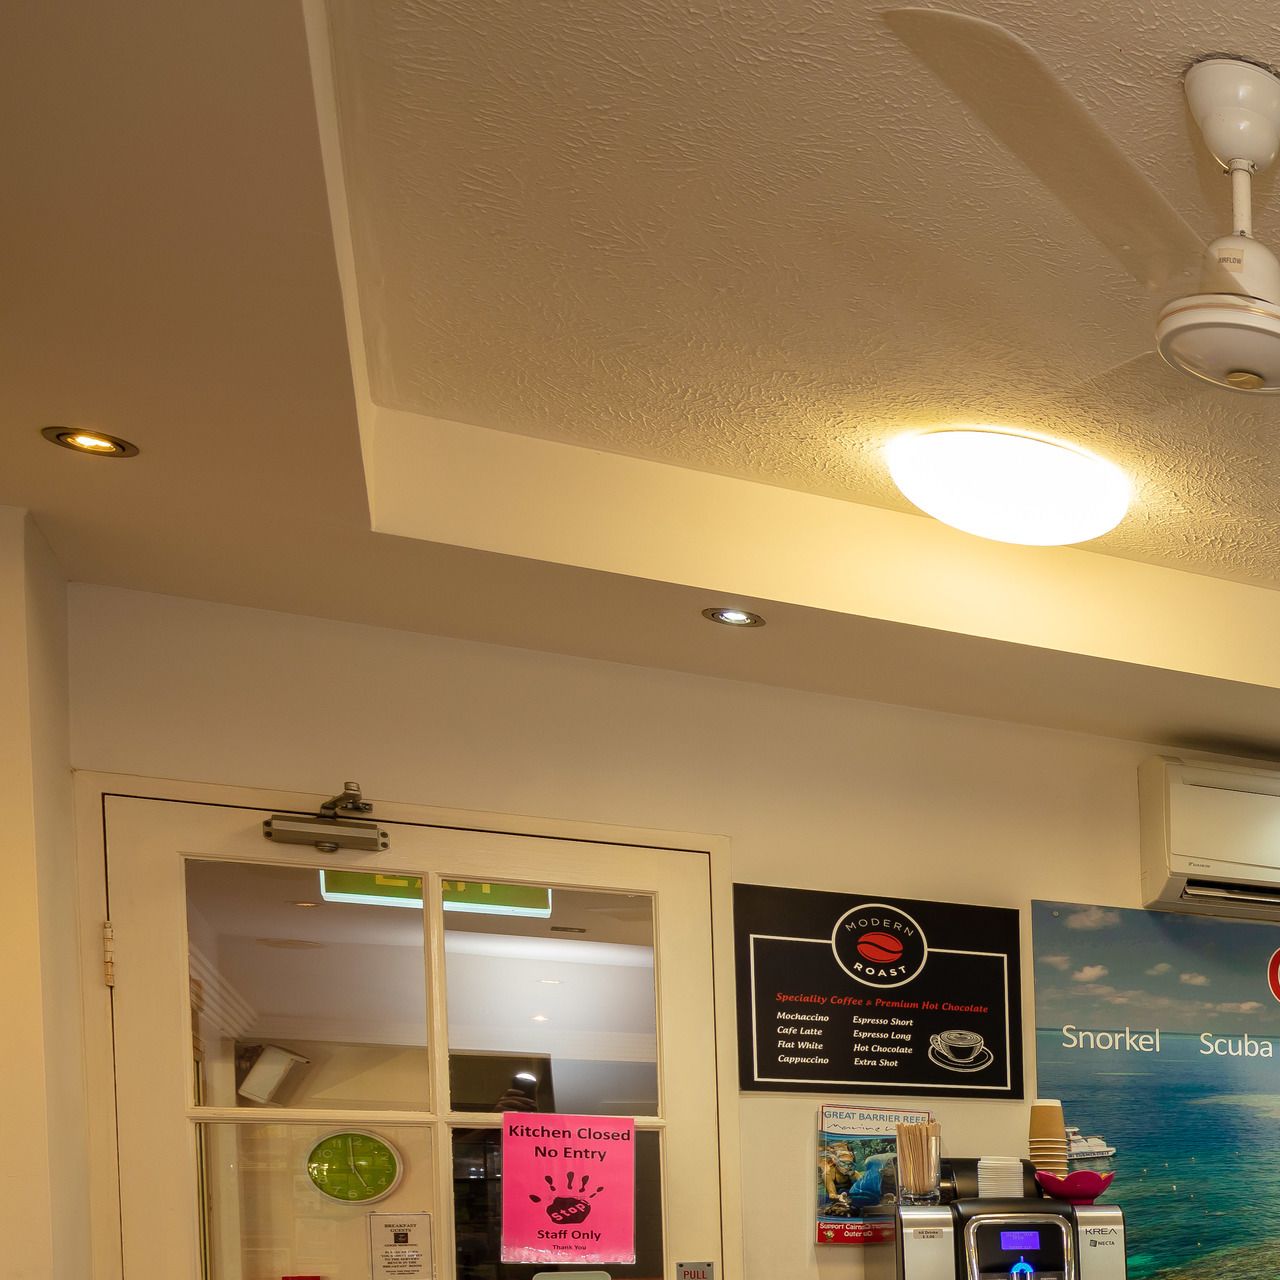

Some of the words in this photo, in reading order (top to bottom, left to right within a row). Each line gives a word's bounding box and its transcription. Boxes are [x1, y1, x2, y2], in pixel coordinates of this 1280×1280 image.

[845, 918, 914, 936] MODERN
[853, 962, 906, 977] ROAST
[776, 992, 827, 1005] Speciality
[830, 995, 863, 1007] Coffee
[875, 998, 919, 1009] Premium
[922, 1001, 939, 1011] Hot
[942, 1002, 989, 1014] Chocolate
[776, 1011, 829, 1022] Mochaccino
[853, 1016, 888, 1026] Espresso
[890, 1017, 914, 1027] Short
[777, 1026, 798, 1036] Cafe
[800, 1026, 823, 1036] Latte
[853, 1030, 889, 1041] Espresso
[891, 1031, 912, 1042] Long
[1062, 1024, 1160, 1052] Snorkel
[777, 1040, 795, 1049] Flat
[798, 1041, 823, 1050] White
[854, 1044, 869, 1053] Hot
[871, 1044, 913, 1054] Chocolate
[1200, 1032, 1273, 1059] Scuba
[778, 1054, 829, 1065] Cappuccino
[854, 1058, 877, 1067] Extra
[879, 1058, 898, 1068] Shot
[824, 1110, 856, 1119] GREAT
[859, 1113, 900, 1123] BARRIER
[509, 1125, 572, 1139] Kitchen
[577, 1128, 631, 1141] Closed
[534, 1146, 558, 1158] No
[563, 1147, 607, 1162] Entry
[537, 1229, 568, 1240] Staff
[571, 1230, 601, 1242] Only
[683, 1270, 708, 1280] PULL
